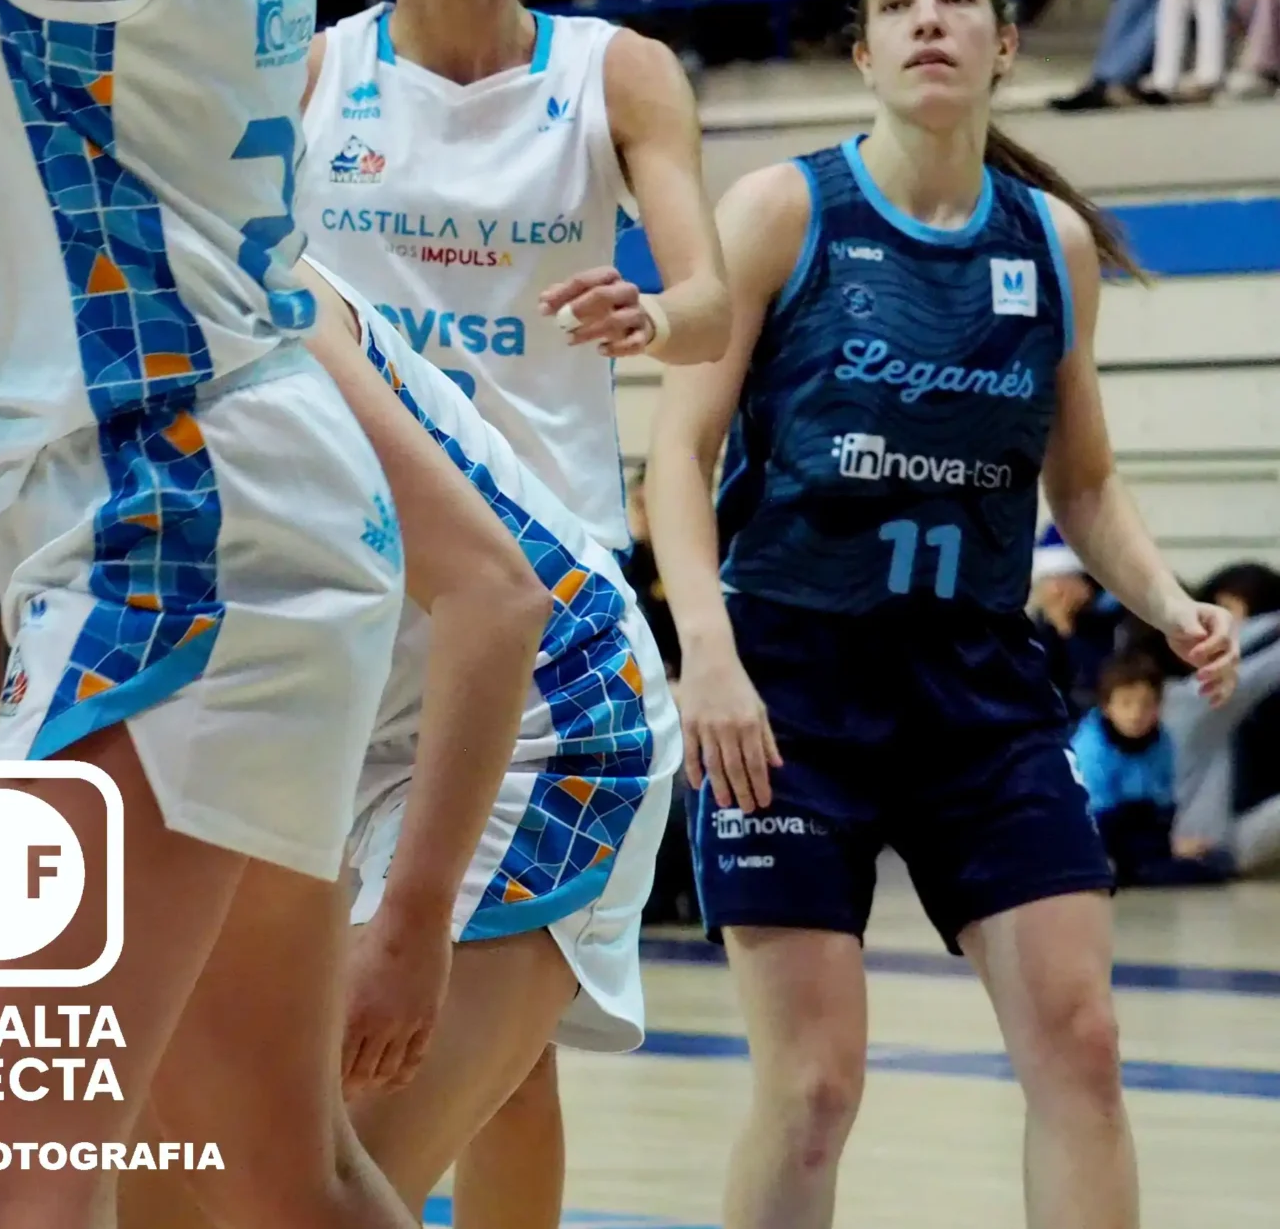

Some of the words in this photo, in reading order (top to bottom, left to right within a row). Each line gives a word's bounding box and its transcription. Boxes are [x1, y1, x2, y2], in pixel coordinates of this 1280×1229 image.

[321, 208, 459, 240] CASTILLA
[478, 219, 499, 246] Y
[510, 214, 584, 245] LEÓN
[421, 246, 513, 268] IMPULSA
[834, 338, 1035, 404] Leganés
[878, 518, 962, 600] 11
